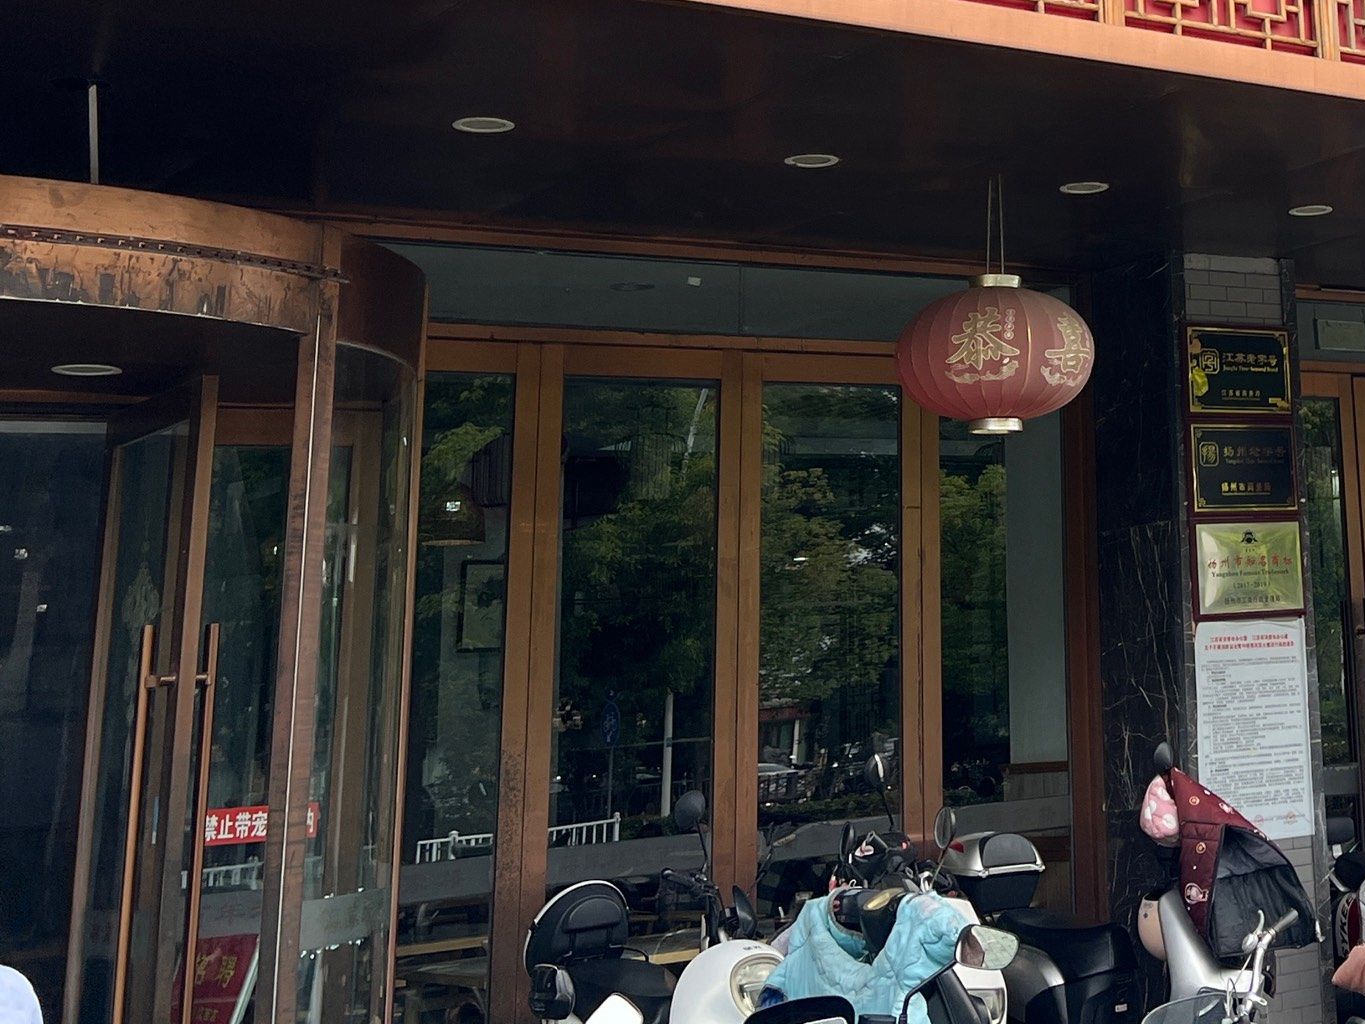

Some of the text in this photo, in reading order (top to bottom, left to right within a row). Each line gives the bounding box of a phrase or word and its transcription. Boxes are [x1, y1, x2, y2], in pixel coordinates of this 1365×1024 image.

[1222, 352, 1278, 366] 江苏老字号
